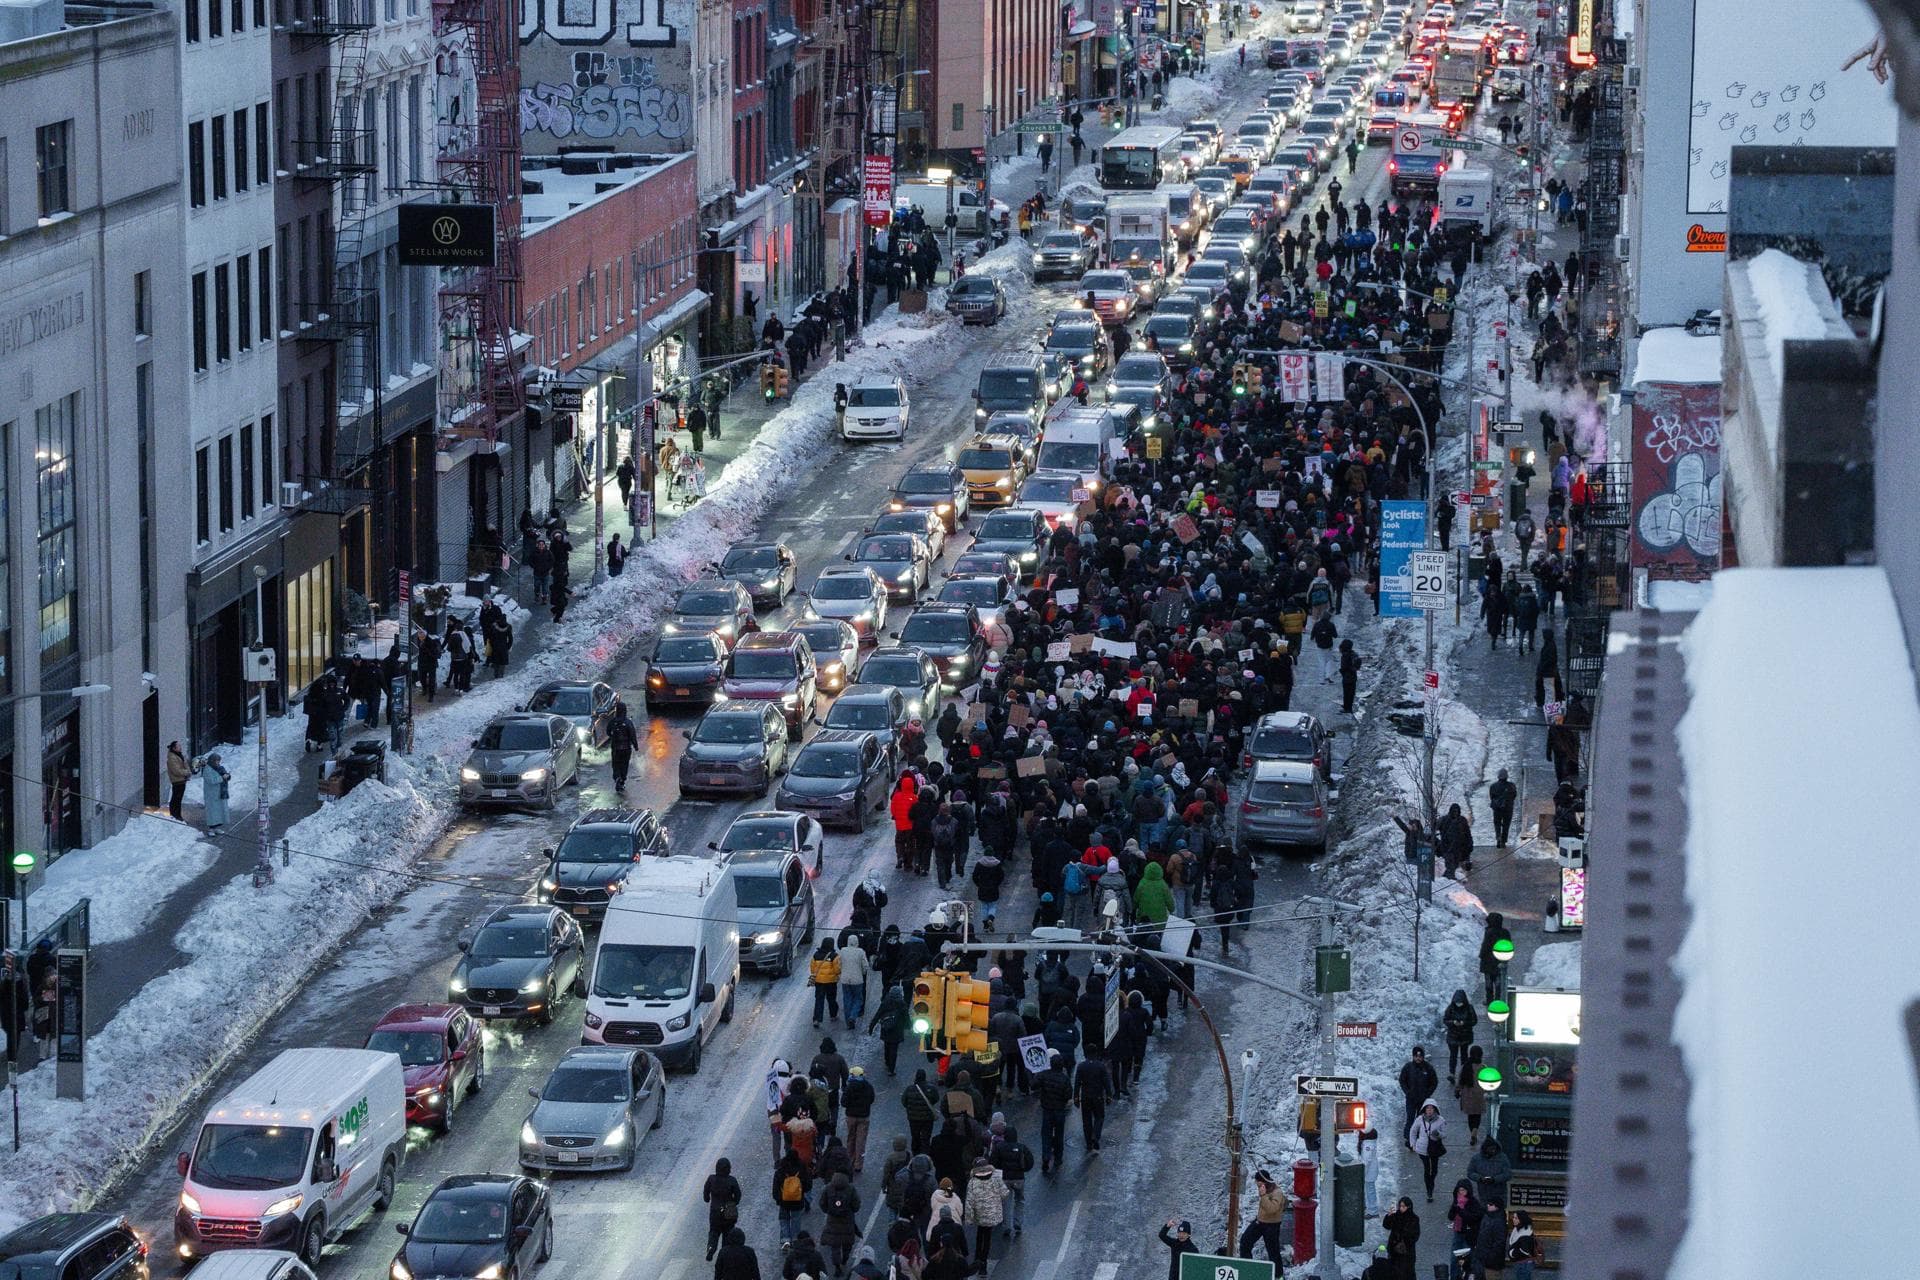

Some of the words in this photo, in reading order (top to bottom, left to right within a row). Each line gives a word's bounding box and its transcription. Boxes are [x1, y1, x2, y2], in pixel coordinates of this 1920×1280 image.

[409, 248, 449, 256] STELLAR
[452, 248, 485, 256] WORKS
[1383, 510, 1424, 520] Cyclists:
[1382, 541, 1424, 549] Pedestrians
[1415, 555, 1444, 564] SPEED
[1418, 564, 1441, 572] LIMIT
[1416, 575, 1442, 592] 20
[1337, 1026, 1372, 1037] Broadway
[1307, 1081, 1324, 1090] ONE
[1334, 1082, 1352, 1091] WAY
[1217, 1268, 1236, 1280] 9A
